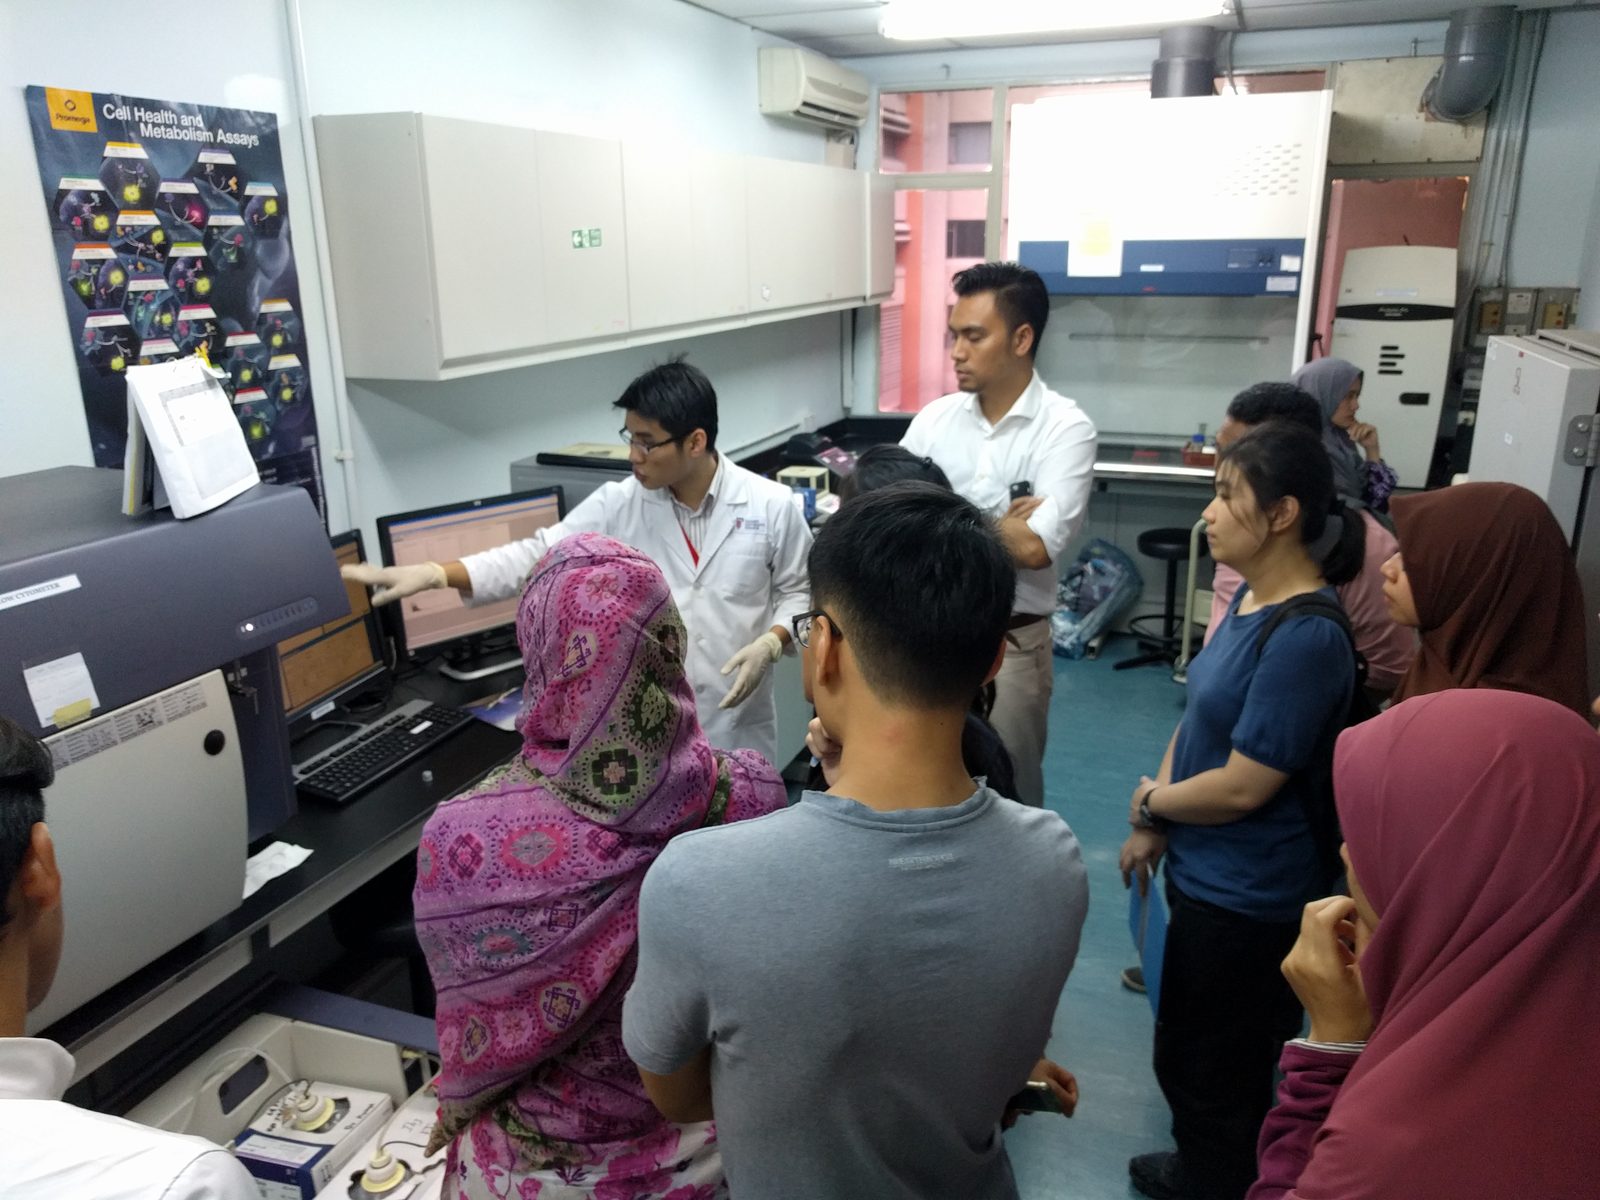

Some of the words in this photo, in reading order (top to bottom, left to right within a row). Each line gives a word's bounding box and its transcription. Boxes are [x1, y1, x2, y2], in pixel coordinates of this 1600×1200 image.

[103, 103, 131, 121] Cell
[134, 107, 178, 125] Health
[180, 114, 205, 128] and
[139, 122, 214, 143] Metabolism
[216, 128, 260, 149] Assays
